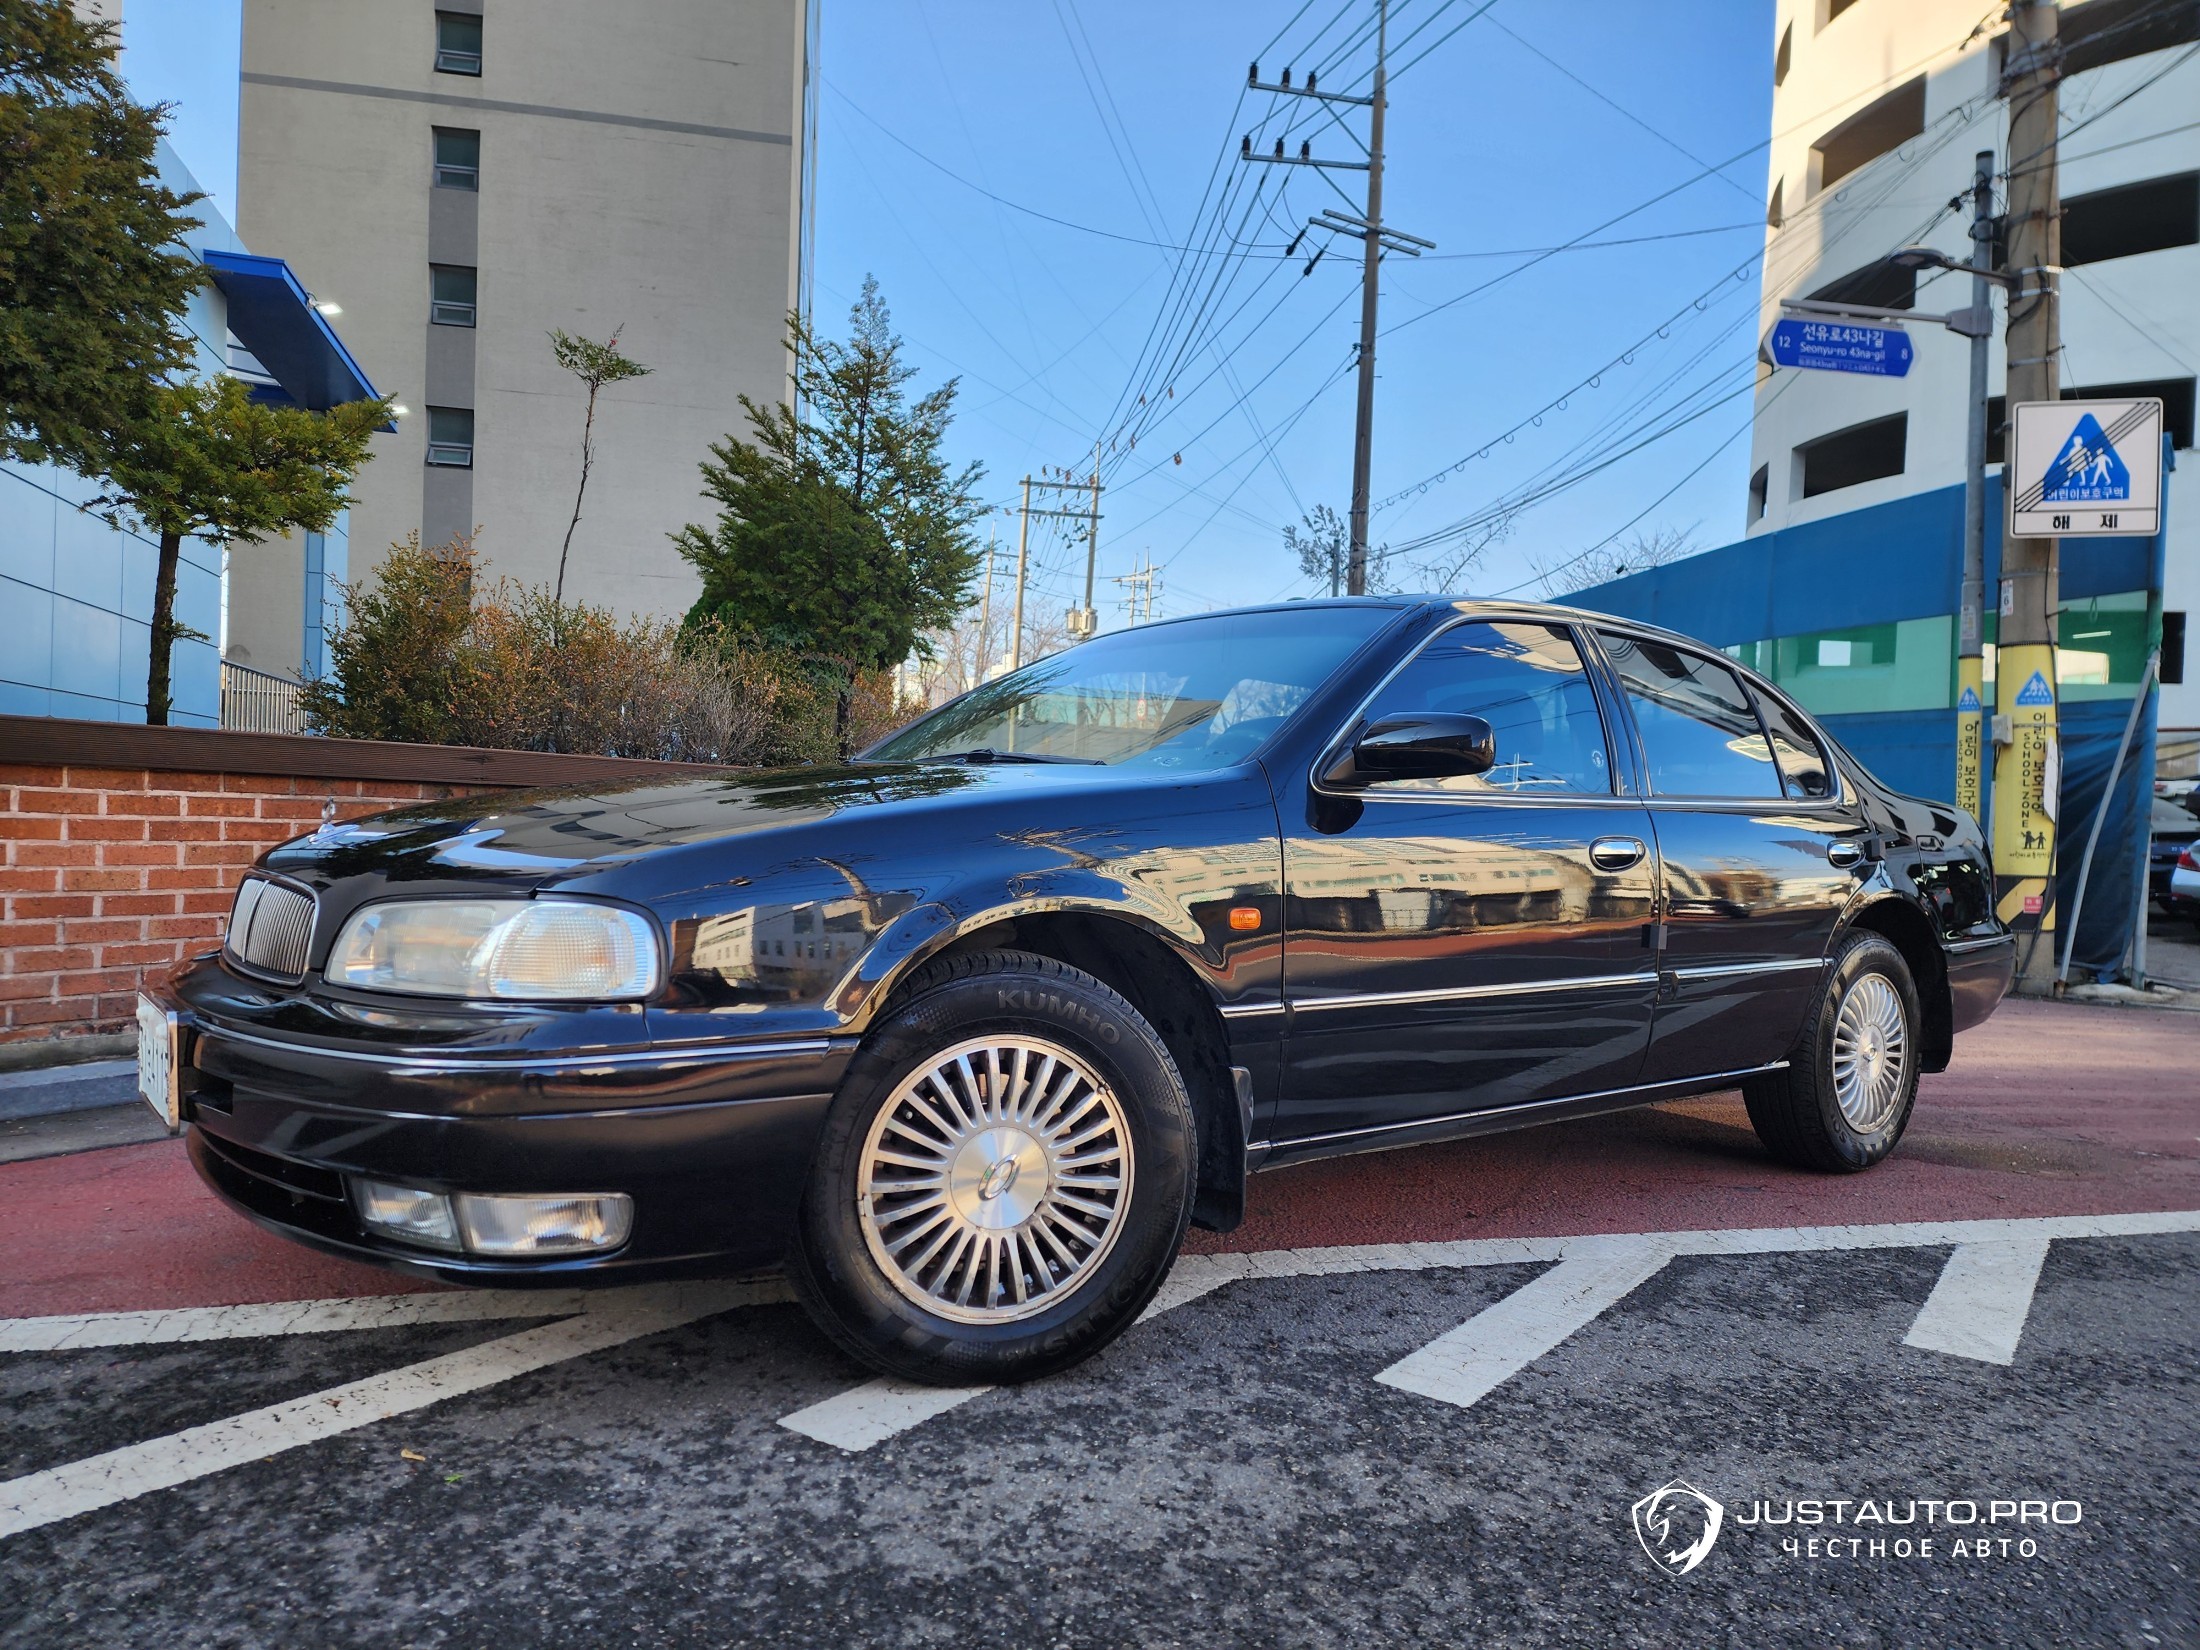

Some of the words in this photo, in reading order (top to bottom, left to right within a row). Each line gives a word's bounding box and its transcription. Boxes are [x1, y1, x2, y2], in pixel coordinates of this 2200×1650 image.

[1778, 335, 1791, 348] 12
[1802, 323, 1884, 348] 선유로43나길
[1800, 341, 1847, 357] Seonyu-ro
[1901, 349, 1908, 360] 8
[2022, 732, 2031, 787] SCHOOL
[2021, 791, 2031, 828] ZONE
[998, 990, 1120, 1045] KUMHO
